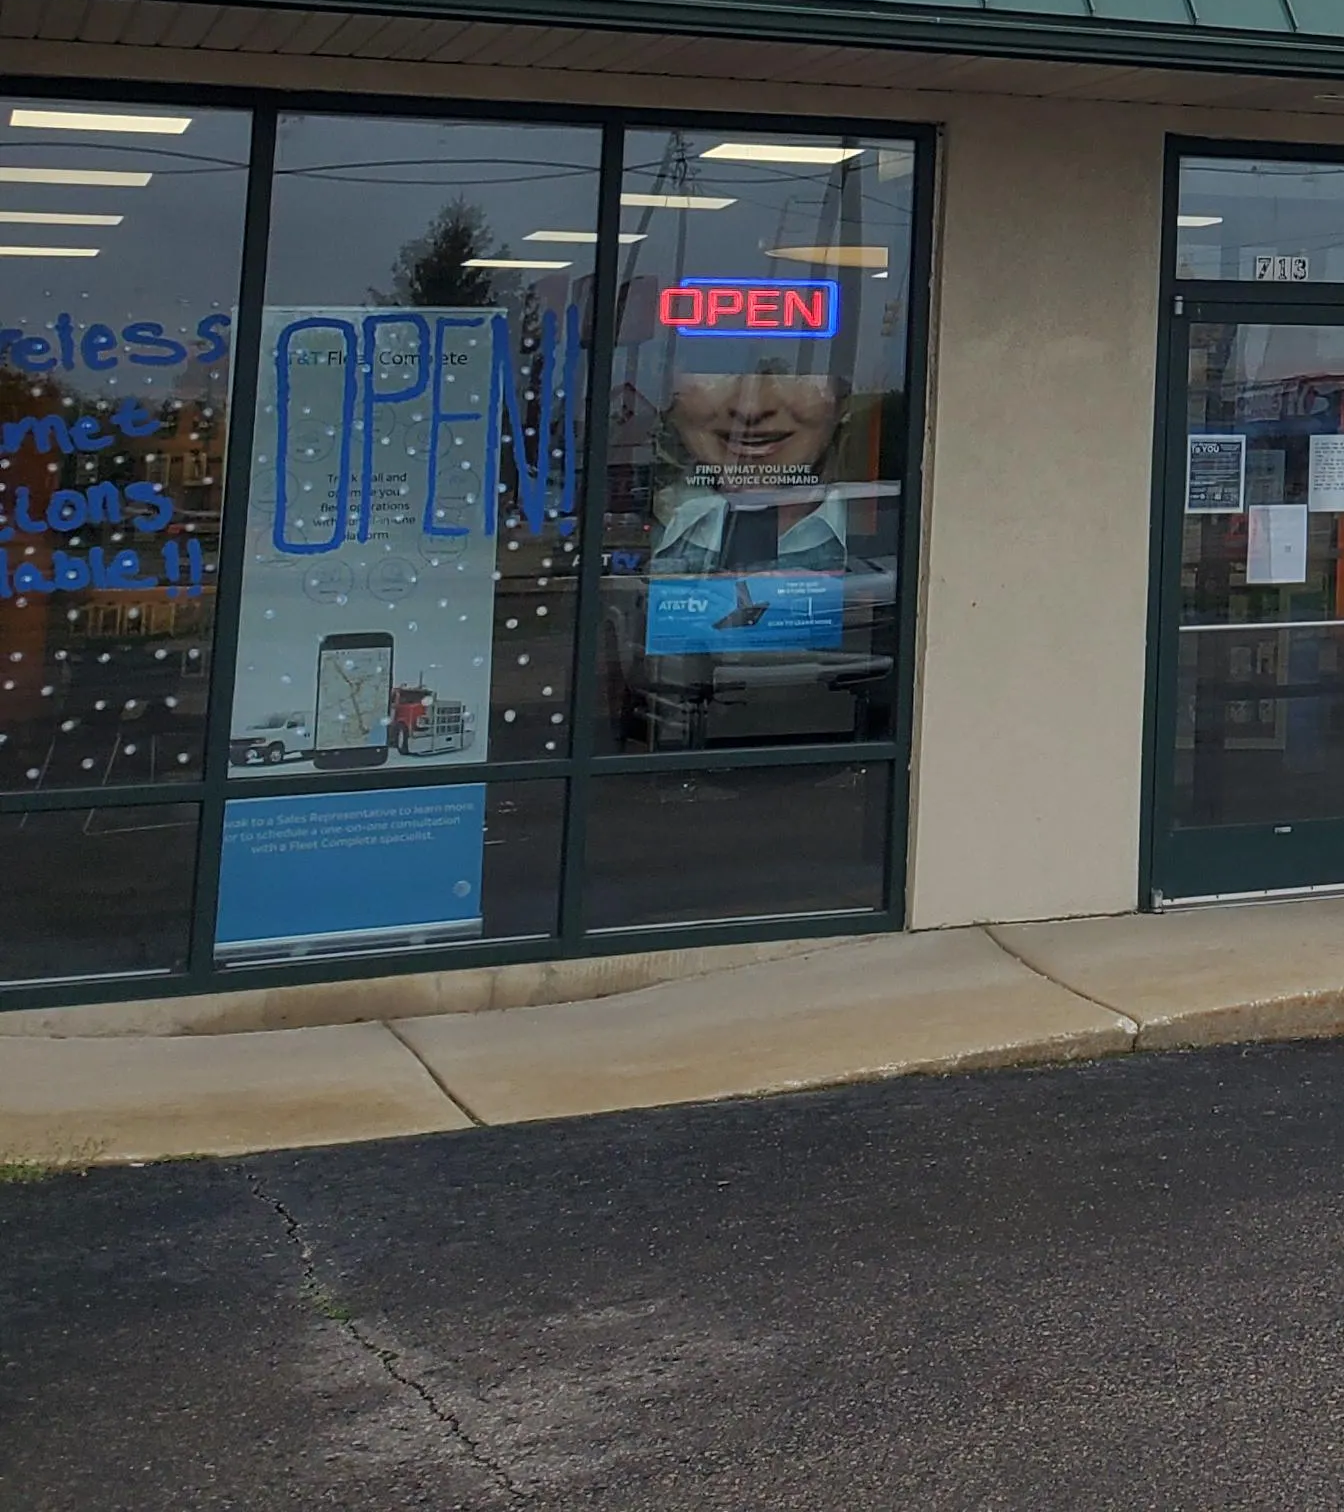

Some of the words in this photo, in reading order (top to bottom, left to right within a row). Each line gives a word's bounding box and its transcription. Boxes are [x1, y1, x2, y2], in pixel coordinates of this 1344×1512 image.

[1258, 258, 1306, 280] 713
[659, 287, 823, 327] OPEN
[275, 351, 322, 366] T&T
[327, 351, 371, 366] Fle
[379, 350, 468, 368] Comete
[695, 465, 722, 474] FIND
[724, 465, 756, 474] WHAT
[758, 465, 781, 474] YOU
[782, 464, 811, 473] LOVE
[386, 472, 407, 482] and
[686, 476, 715, 485] WITH
[717, 476, 725, 484] A
[727, 476, 760, 485] VOICE
[762, 475, 819, 484] COMMAND
[350, 502, 410, 514] oprations
